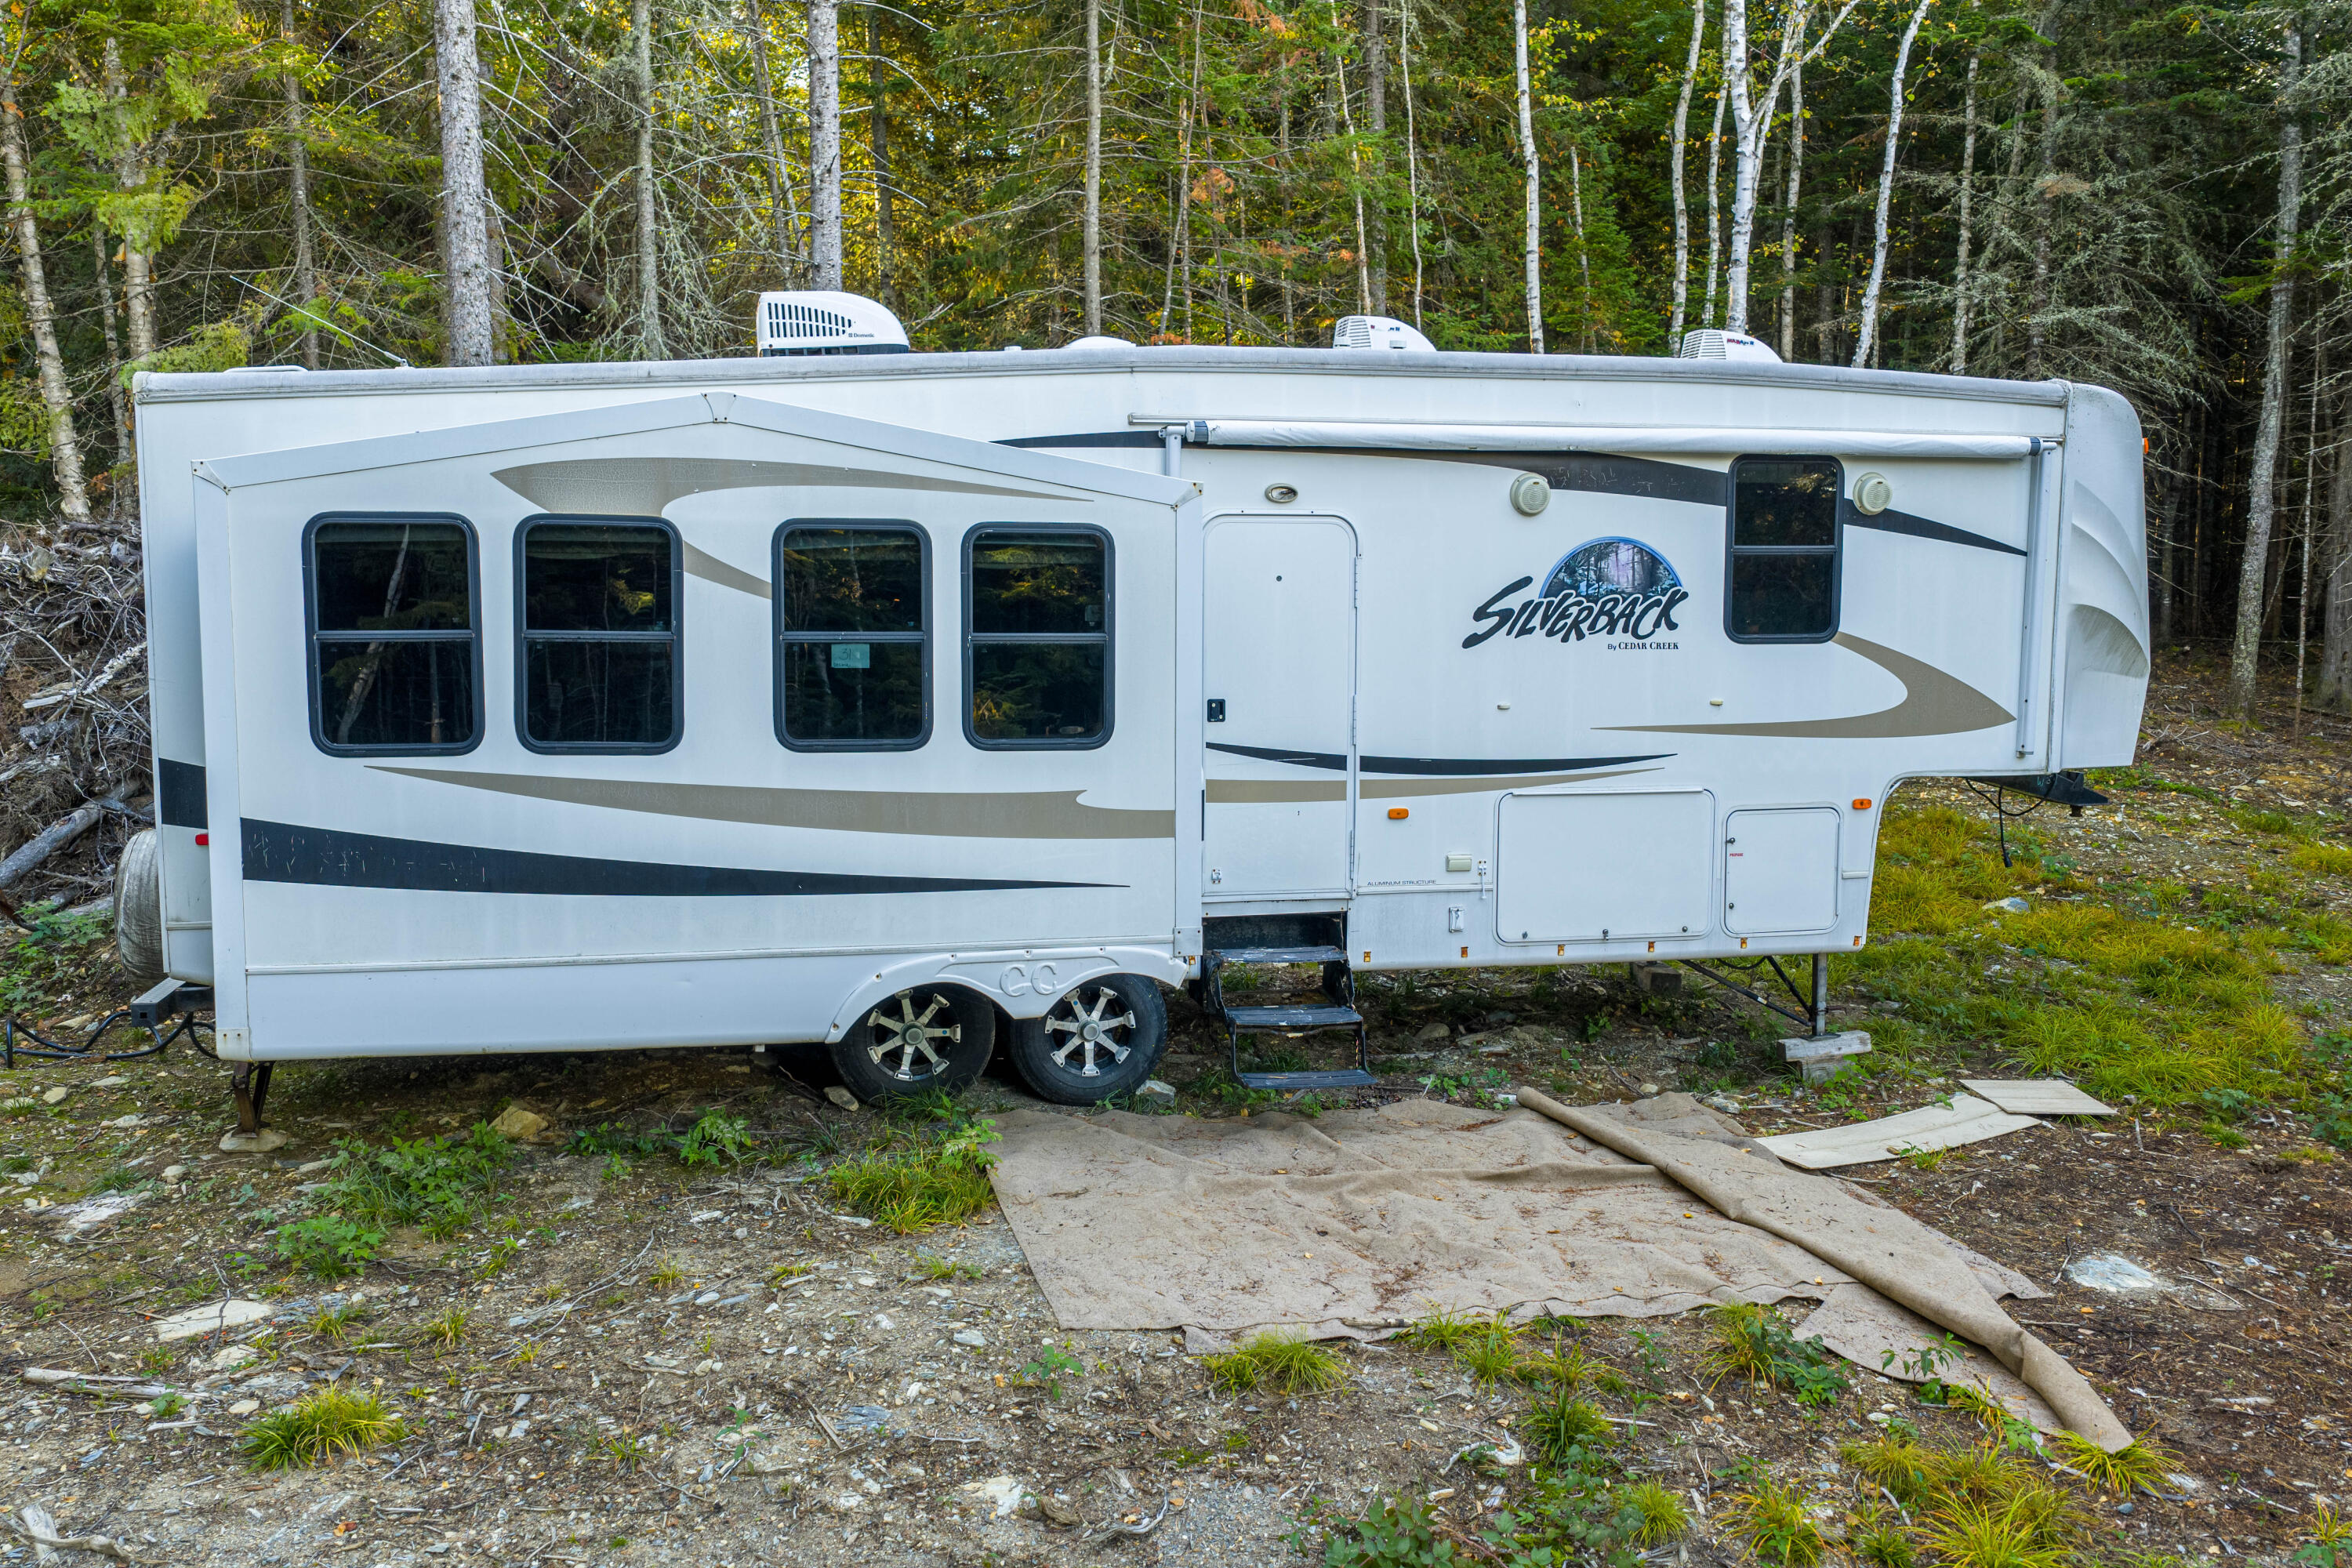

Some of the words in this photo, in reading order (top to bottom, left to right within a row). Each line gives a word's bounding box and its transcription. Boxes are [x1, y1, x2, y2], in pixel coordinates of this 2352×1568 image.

[1461, 575, 1690, 649] SILVERBACK
[1618, 641, 1647, 650] CEDAR
[1650, 641, 1679, 650] CREEK
